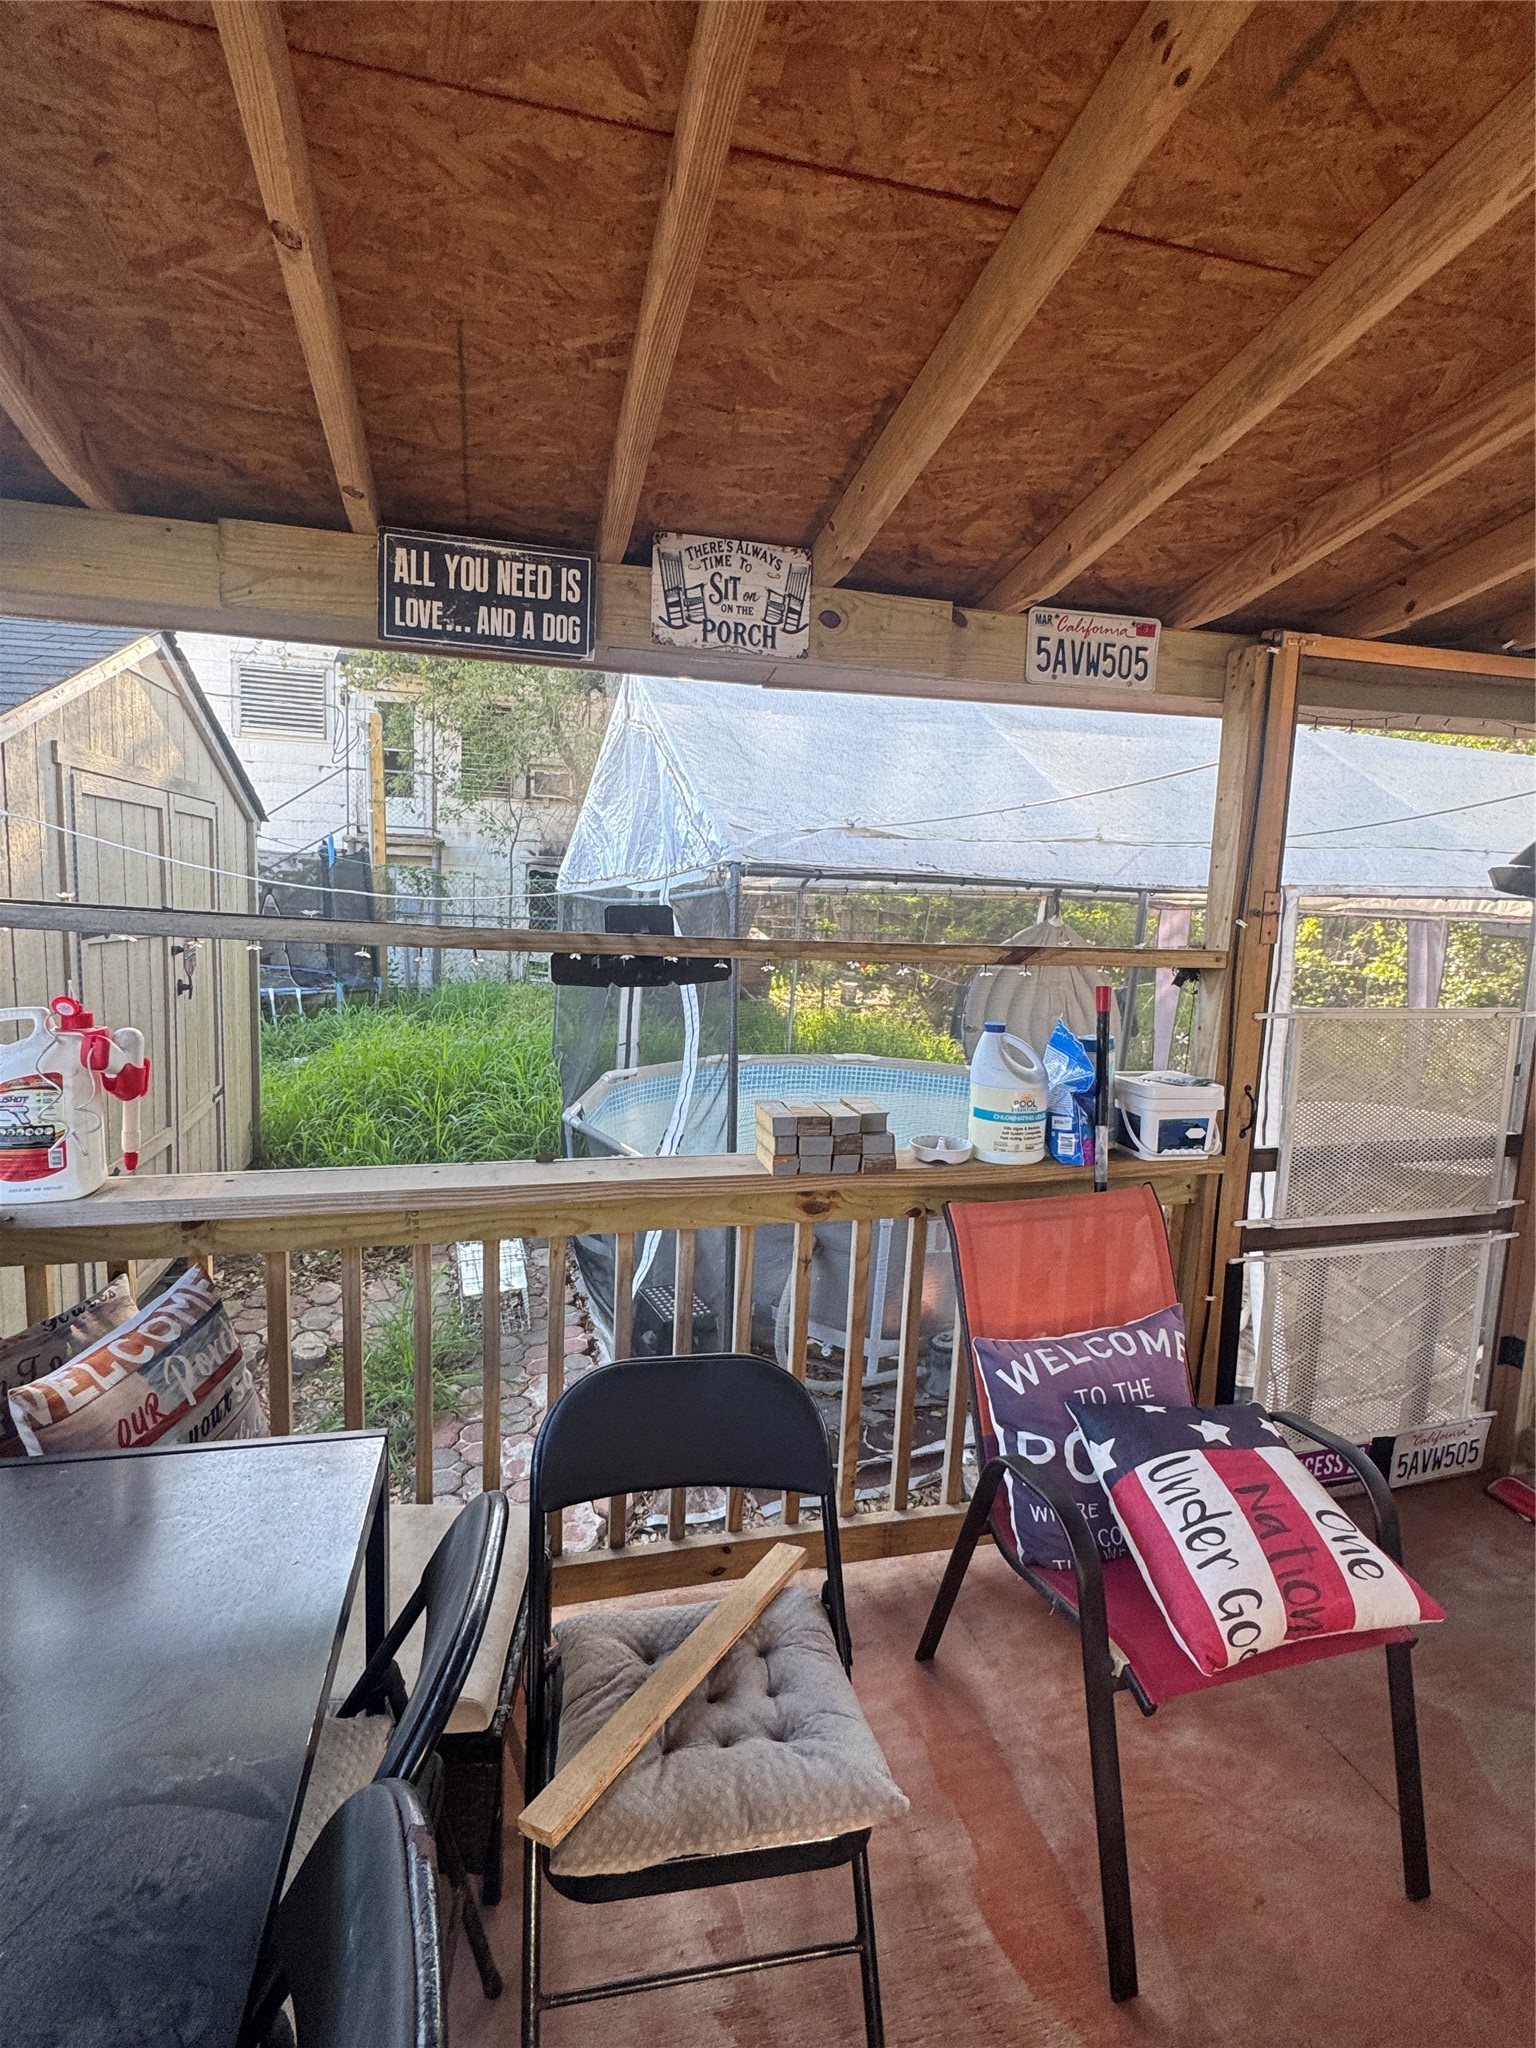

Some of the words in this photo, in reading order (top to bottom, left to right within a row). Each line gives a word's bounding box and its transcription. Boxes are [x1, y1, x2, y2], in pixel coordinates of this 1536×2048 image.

[685, 539, 734, 561] THERE'S
[736, 540, 783, 571] ALWAYS
[700, 555, 732, 571] TIME
[394, 547, 436, 587] ALL
[444, 553, 489, 593] YOU
[497, 559, 552, 600] NEED
[560, 567, 581, 603] IS
[477, 606, 516, 638] AND
[522, 611, 535, 640] A
[542, 612, 580, 645] DOG
[721, 604, 733, 613] ON
[736, 605, 754, 616] THE
[702, 618, 777, 650] PORCH
[1035, 614, 1053, 625] MAR
[1057, 615, 1135, 639] California
[1037, 636, 1149, 681] 5AVW505
[1014, 1099, 1036, 1108] POOL
[995, 1328, 1186, 1395] WELCOME
[1073, 1386, 1107, 1404] TO
[1112, 1378, 1155, 1403] THE
[118, 1392, 170, 1449] OUR
[1412, 1429, 1471, 1446] California
[1301, 1453, 1344, 1476] CESS
[1397, 1439, 1480, 1479] 5AVW505
[1148, 1455, 1240, 1570] Under
[1316, 1510, 1384, 1580] One
